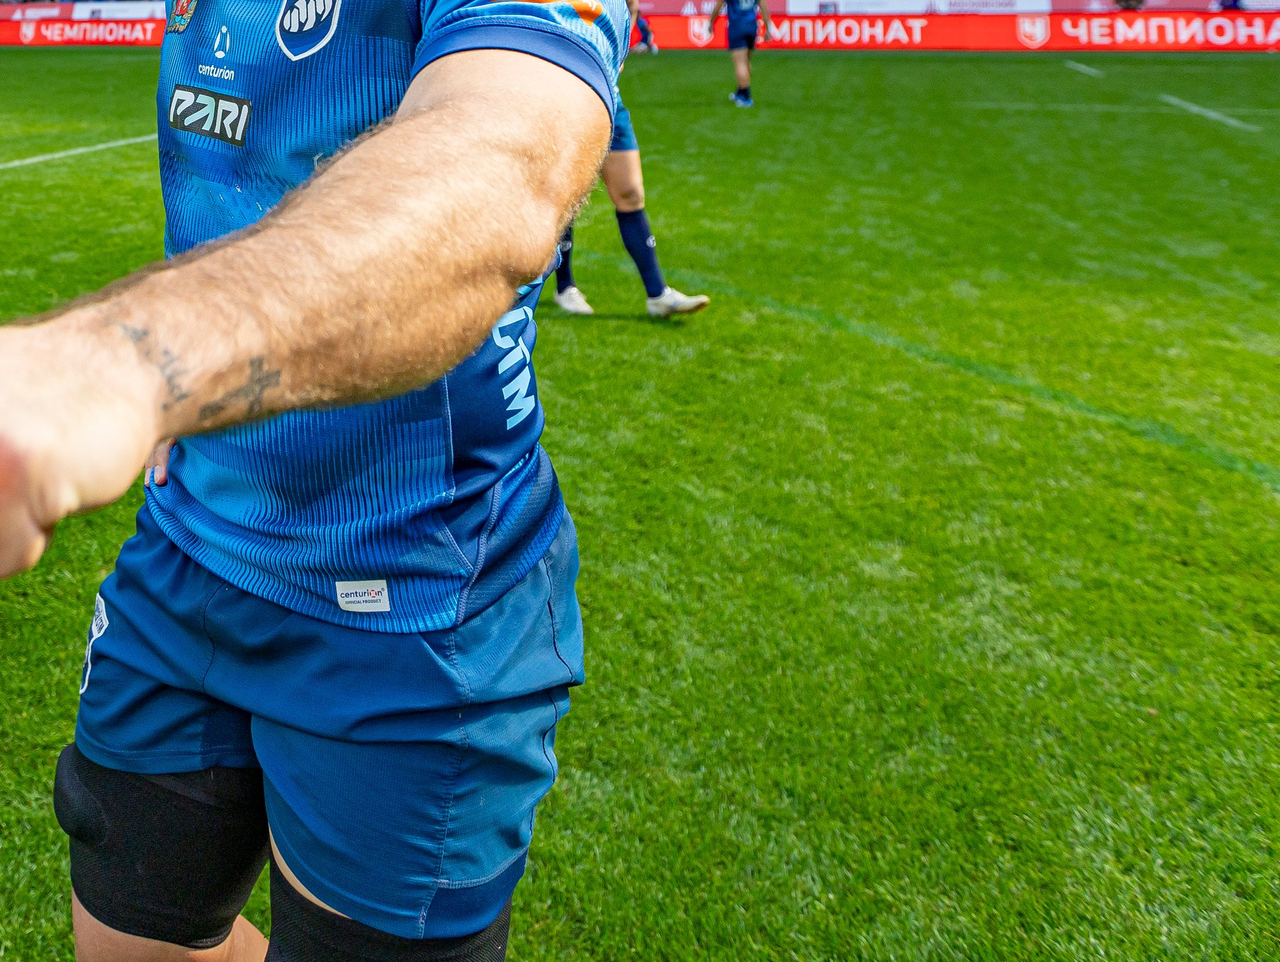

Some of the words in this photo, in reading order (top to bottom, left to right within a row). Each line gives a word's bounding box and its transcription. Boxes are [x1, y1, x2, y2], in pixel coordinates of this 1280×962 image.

[40, 22, 156, 42] ЧЕМПИОНАТ
[756, 18, 928, 45] МПИОНАТ
[198, 64, 235, 81] centurion
[169, 89, 249, 141] PARI
